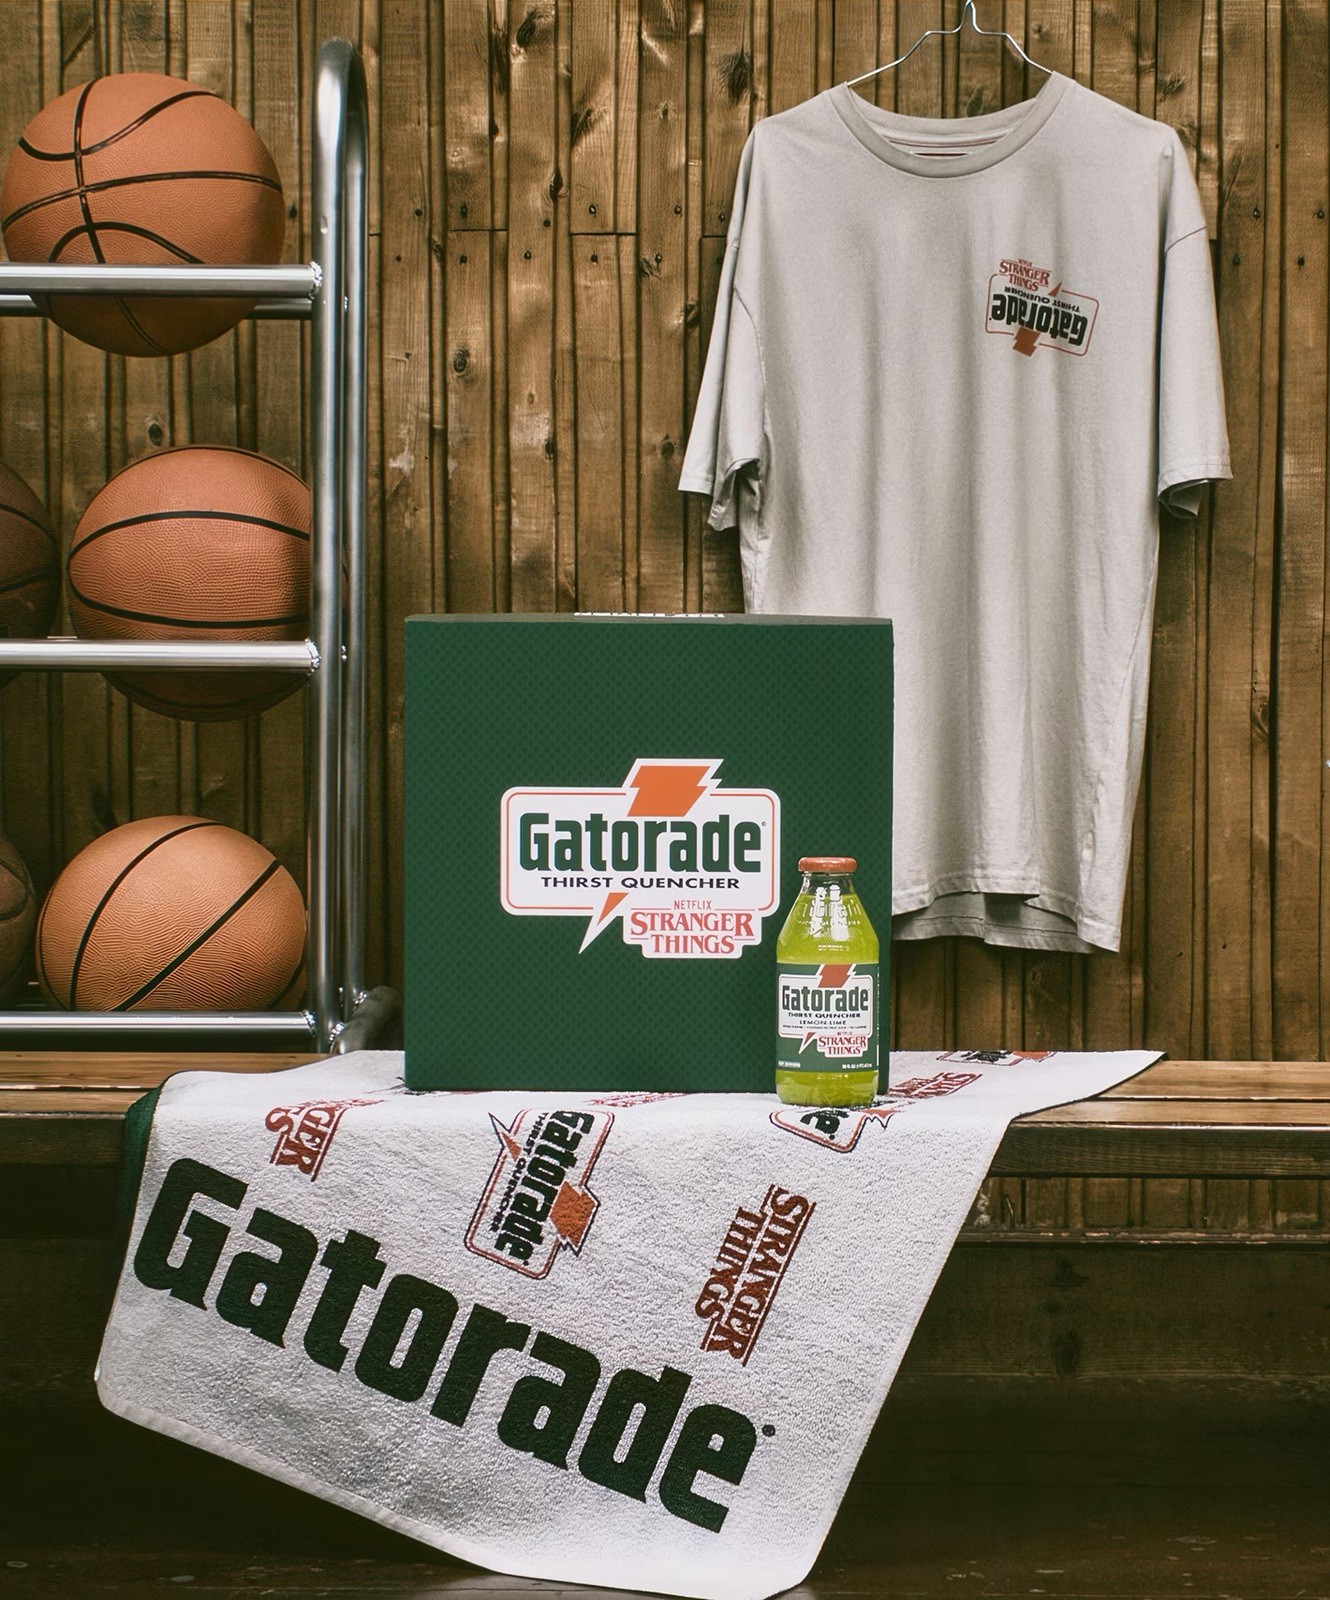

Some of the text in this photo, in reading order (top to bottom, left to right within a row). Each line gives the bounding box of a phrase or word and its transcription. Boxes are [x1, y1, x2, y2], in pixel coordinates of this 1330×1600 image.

[999, 260, 1050, 286] STRANGER
[1009, 273, 1039, 292] THINGS
[991, 293, 1089, 347] Gatorade
[519, 812, 762, 873] Gatorade
[541, 876, 740, 889] THIRST QUENCHER
[673, 900, 712, 911] NETFLIX
[630, 911, 755, 937] STRANGER
[650, 934, 736, 954] THINGS
[782, 985, 869, 1012] Gatorade
[818, 1036, 867, 1048] STRANGER
[827, 1046, 861, 1055] THINGS
[494, 1110, 595, 1261] Gatorade
[695, 1206, 768, 1322] THINGS
[705, 1185, 810, 1360] STRANGER
[132, 1157, 758, 1534] Gatorade
